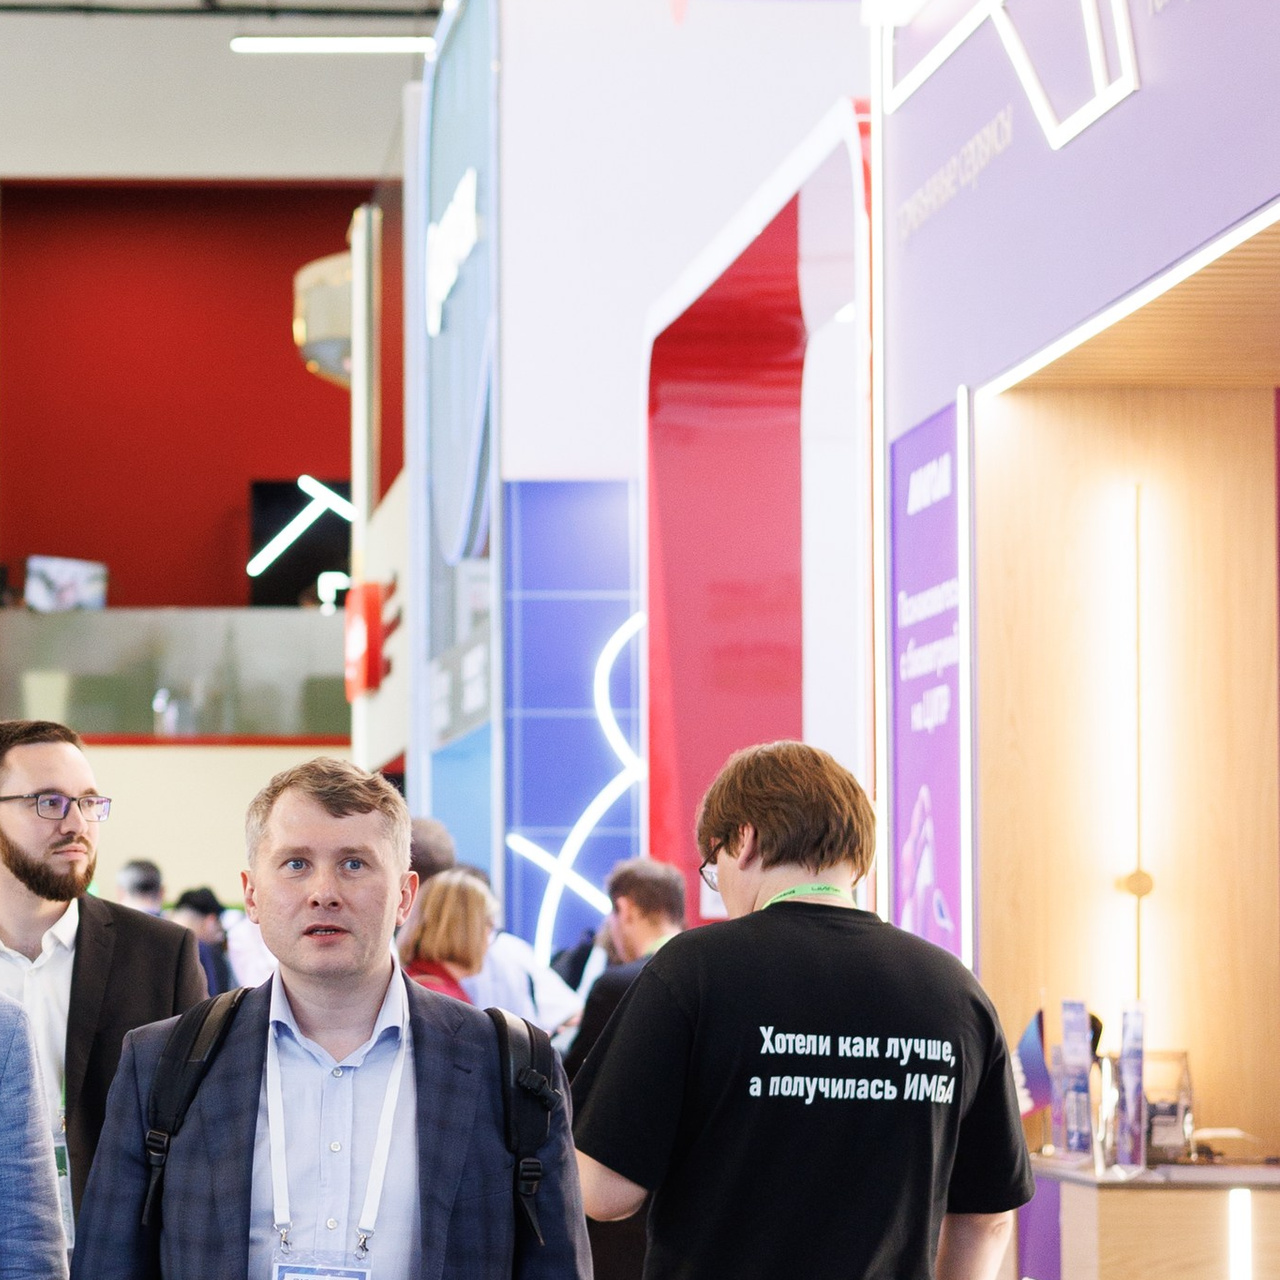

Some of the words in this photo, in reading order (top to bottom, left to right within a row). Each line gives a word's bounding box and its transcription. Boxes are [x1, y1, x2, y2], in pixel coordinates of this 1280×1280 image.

[759, 1026, 831, 1056] Хотели
[838, 1035, 880, 1058] как
[885, 1037, 956, 1068] лучше,
[748, 1076, 762, 1097] а
[768, 1075, 898, 1105] получилась
[903, 1072, 956, 1105] ИМБА
